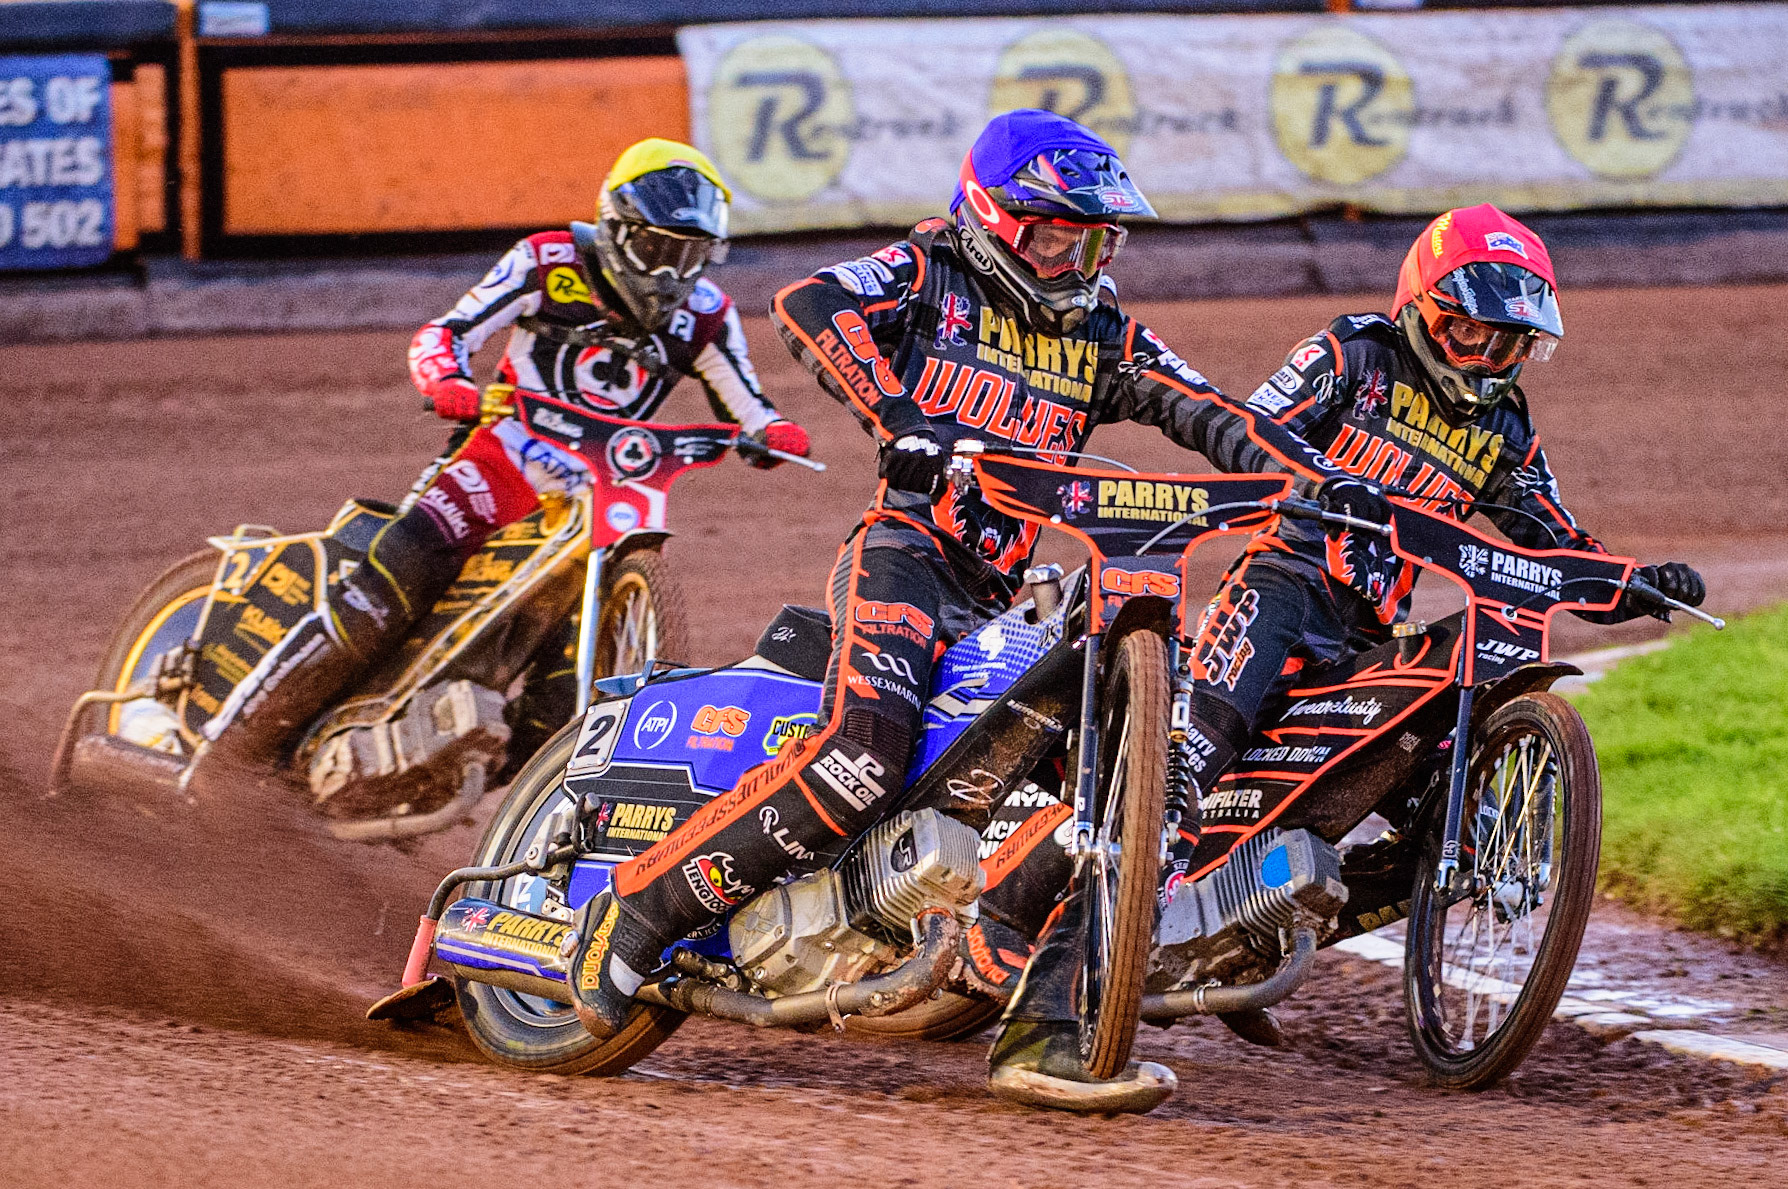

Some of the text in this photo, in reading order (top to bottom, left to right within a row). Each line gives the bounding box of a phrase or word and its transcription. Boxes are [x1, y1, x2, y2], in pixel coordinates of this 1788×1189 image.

[46, 78, 99, 123] OF
[22, 202, 102, 248] 502
[961, 231, 992, 269] Arai
[815, 328, 882, 406] FILTRATION
[911, 356, 1087, 467] WOLVES
[1098, 480, 1209, 513] PARRYS
[223, 551, 250, 588] 2
[1492, 551, 1562, 587] PARRYS
[1476, 638, 1540, 661] JWP
[1478, 652, 1506, 665] racing
[576, 715, 616, 757] 2
[641, 716, 670, 732] ATPI
[1242, 746, 1290, 761] LOCKED
[820, 755, 879, 807] ROCK OIL
[610, 802, 677, 831] PARRYS
[486, 911, 574, 947] PARRYS
